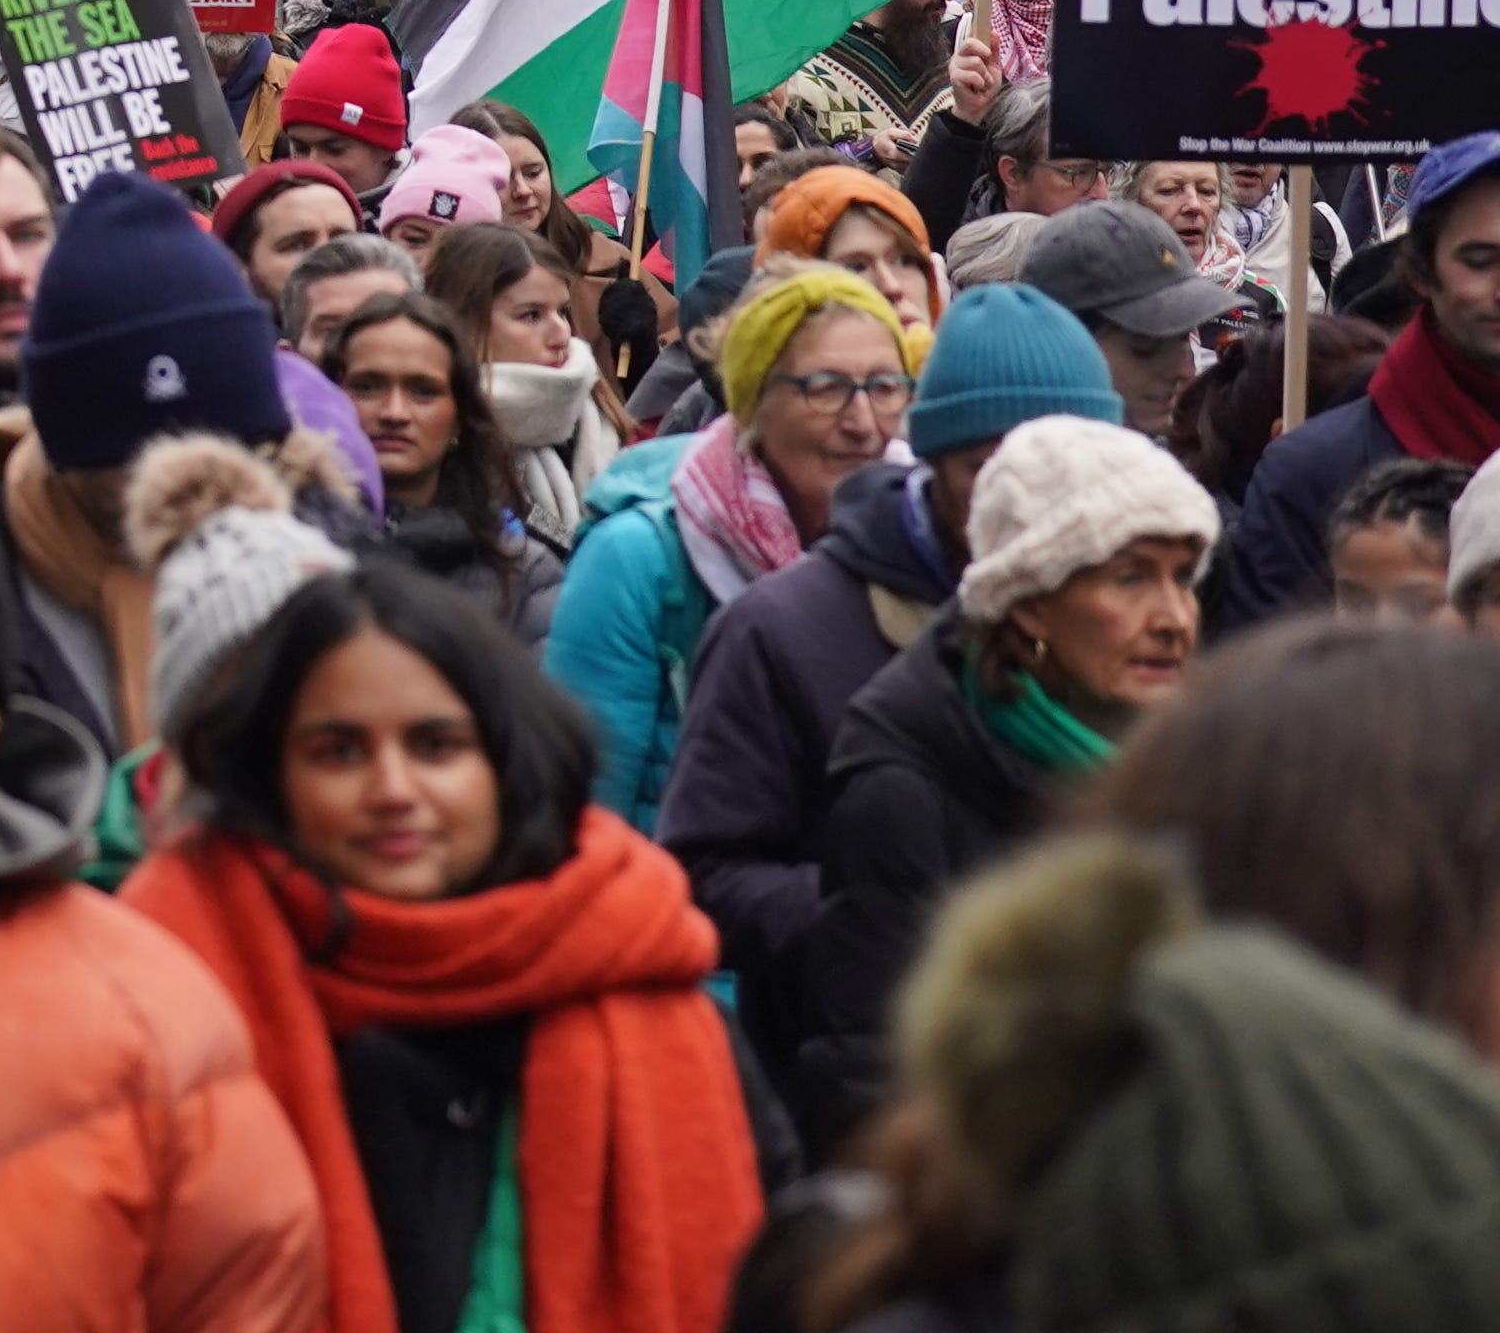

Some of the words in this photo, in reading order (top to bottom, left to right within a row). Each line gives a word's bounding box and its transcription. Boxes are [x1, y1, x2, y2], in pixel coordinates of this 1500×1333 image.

[5, 5, 75, 65] THE
[22, 36, 190, 112] PALESTINE
[37, 100, 121, 159] WILL
[122, 89, 171, 139] BE
[1180, 136, 1208, 152] Stop
[1210, 137, 1229, 151] the
[1232, 137, 1256, 151] War
[1259, 138, 1311, 152] Coalition
[1314, 139, 1431, 154] www.stopwar.org.uk
